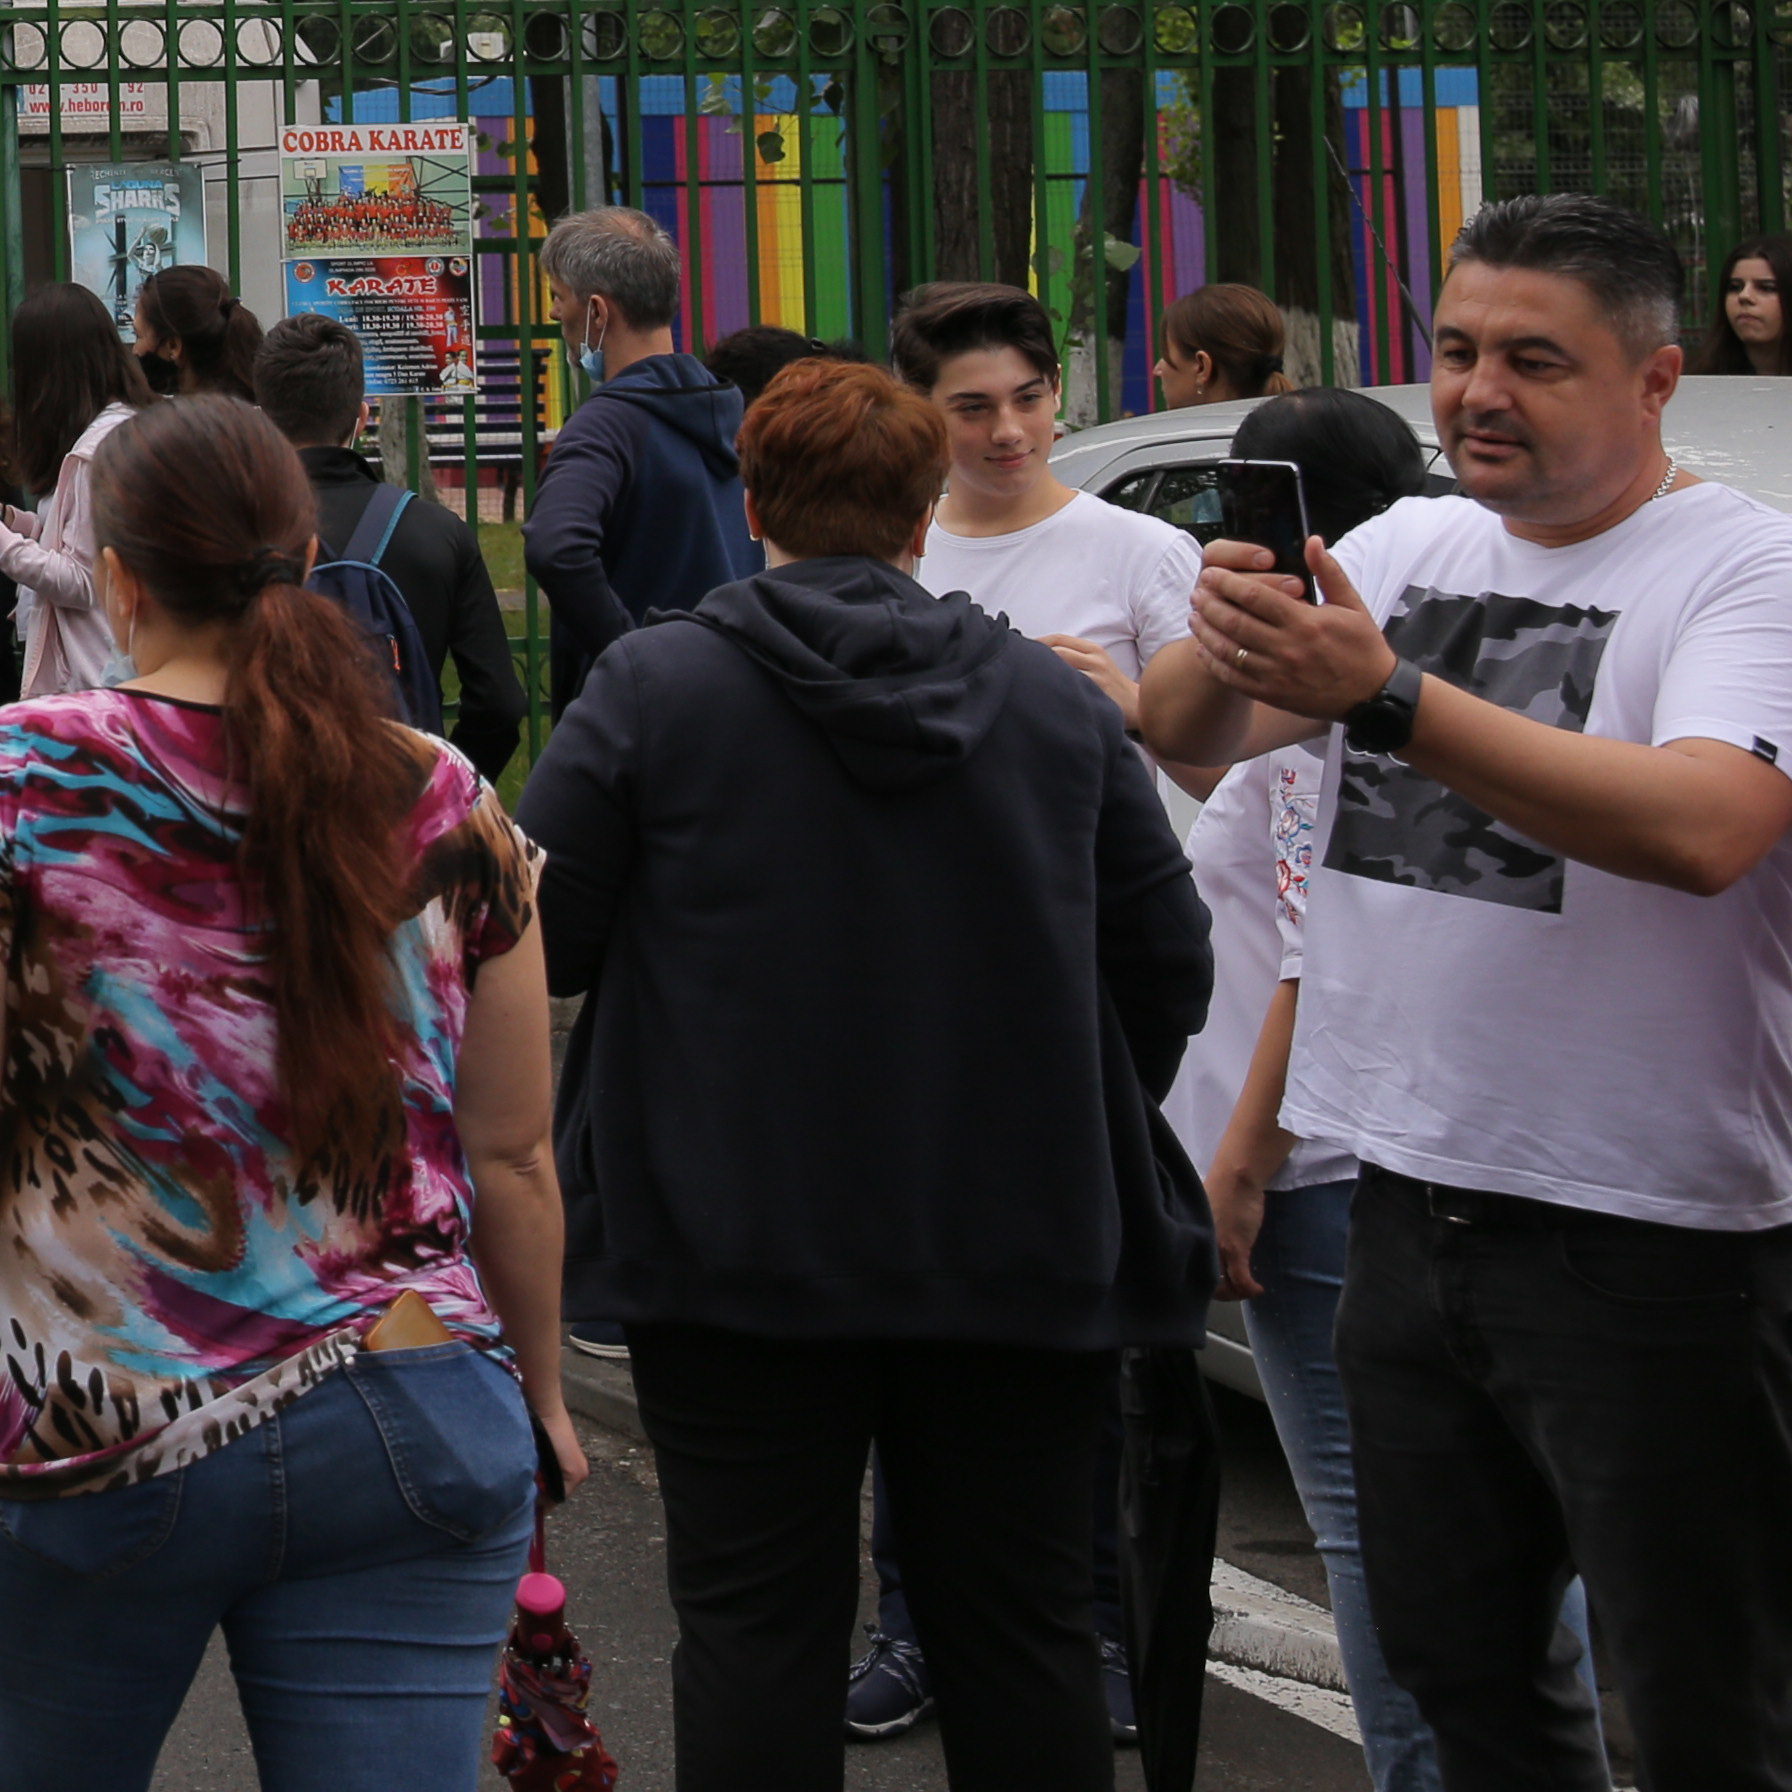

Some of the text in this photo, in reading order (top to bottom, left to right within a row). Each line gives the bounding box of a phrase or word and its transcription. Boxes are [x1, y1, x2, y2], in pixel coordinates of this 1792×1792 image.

[282, 128, 464, 152] COBRA KARATE
[326, 276, 438, 296] KARATE
